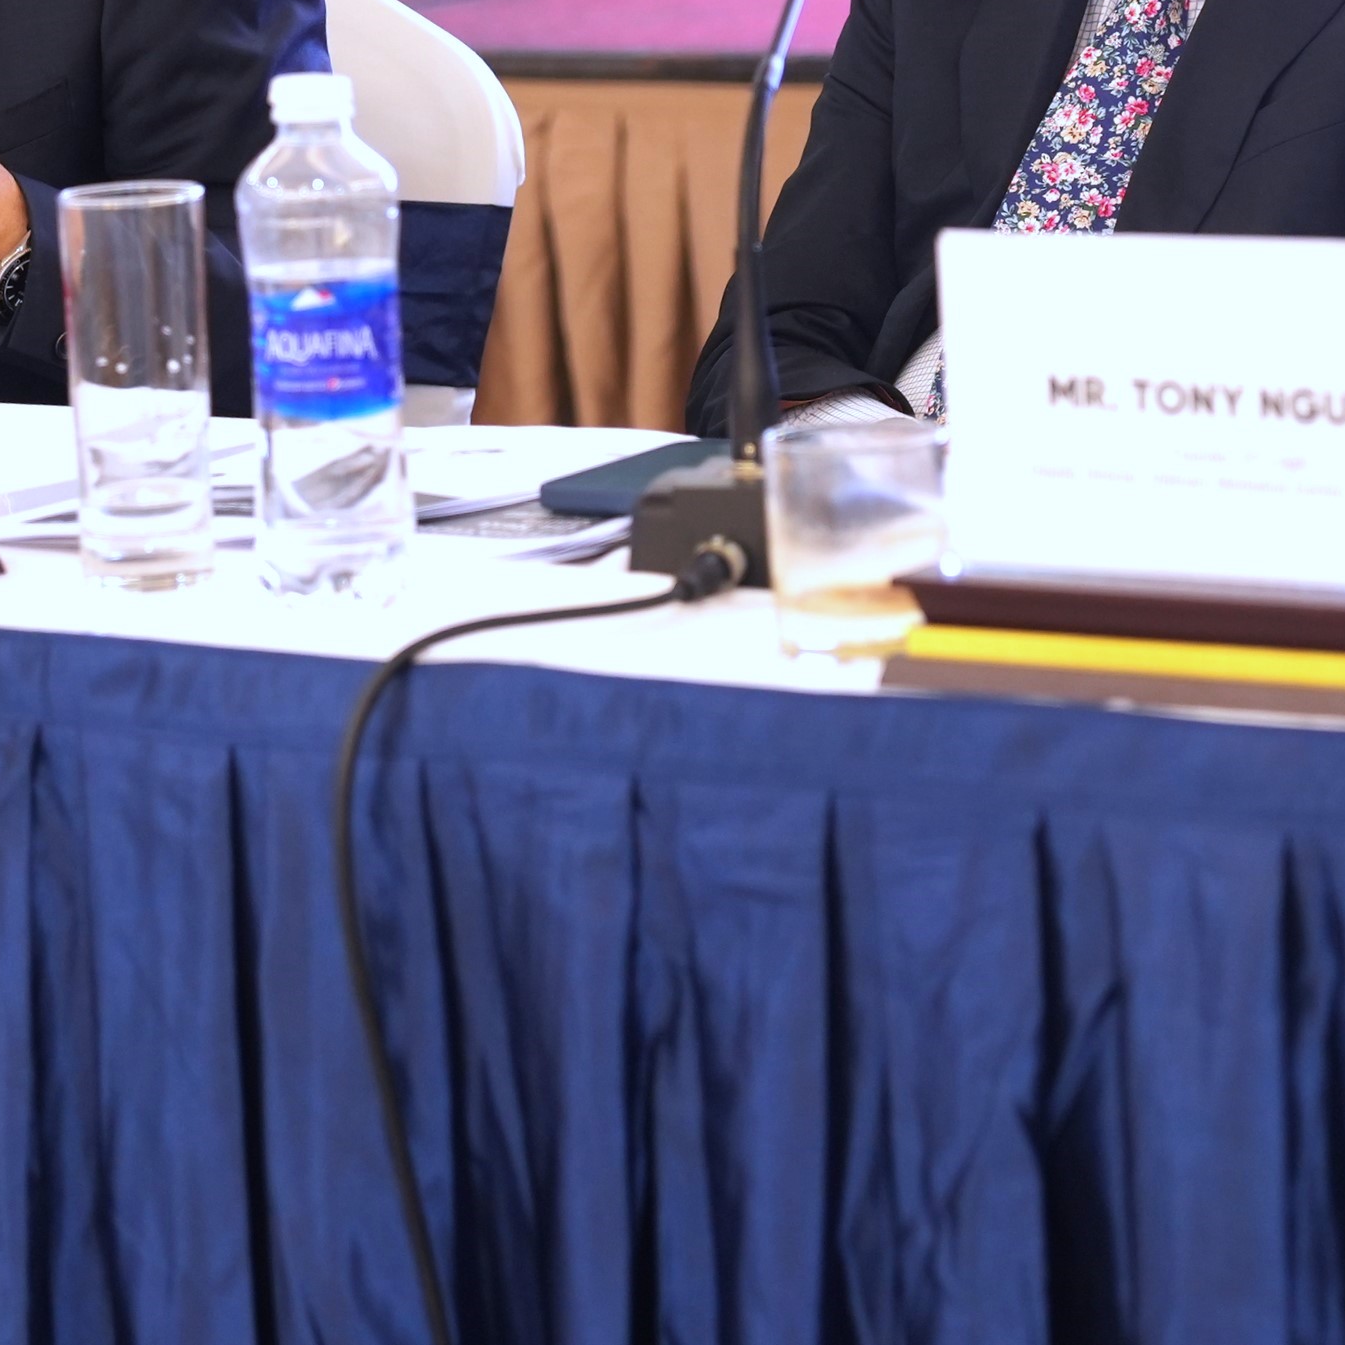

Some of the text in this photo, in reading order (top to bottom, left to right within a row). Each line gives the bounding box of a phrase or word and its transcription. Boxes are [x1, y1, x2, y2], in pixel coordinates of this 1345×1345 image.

[264, 325, 380, 367] AQUAFINA
[1048, 374, 1119, 411] MR.
[1133, 377, 1244, 417] TONY
